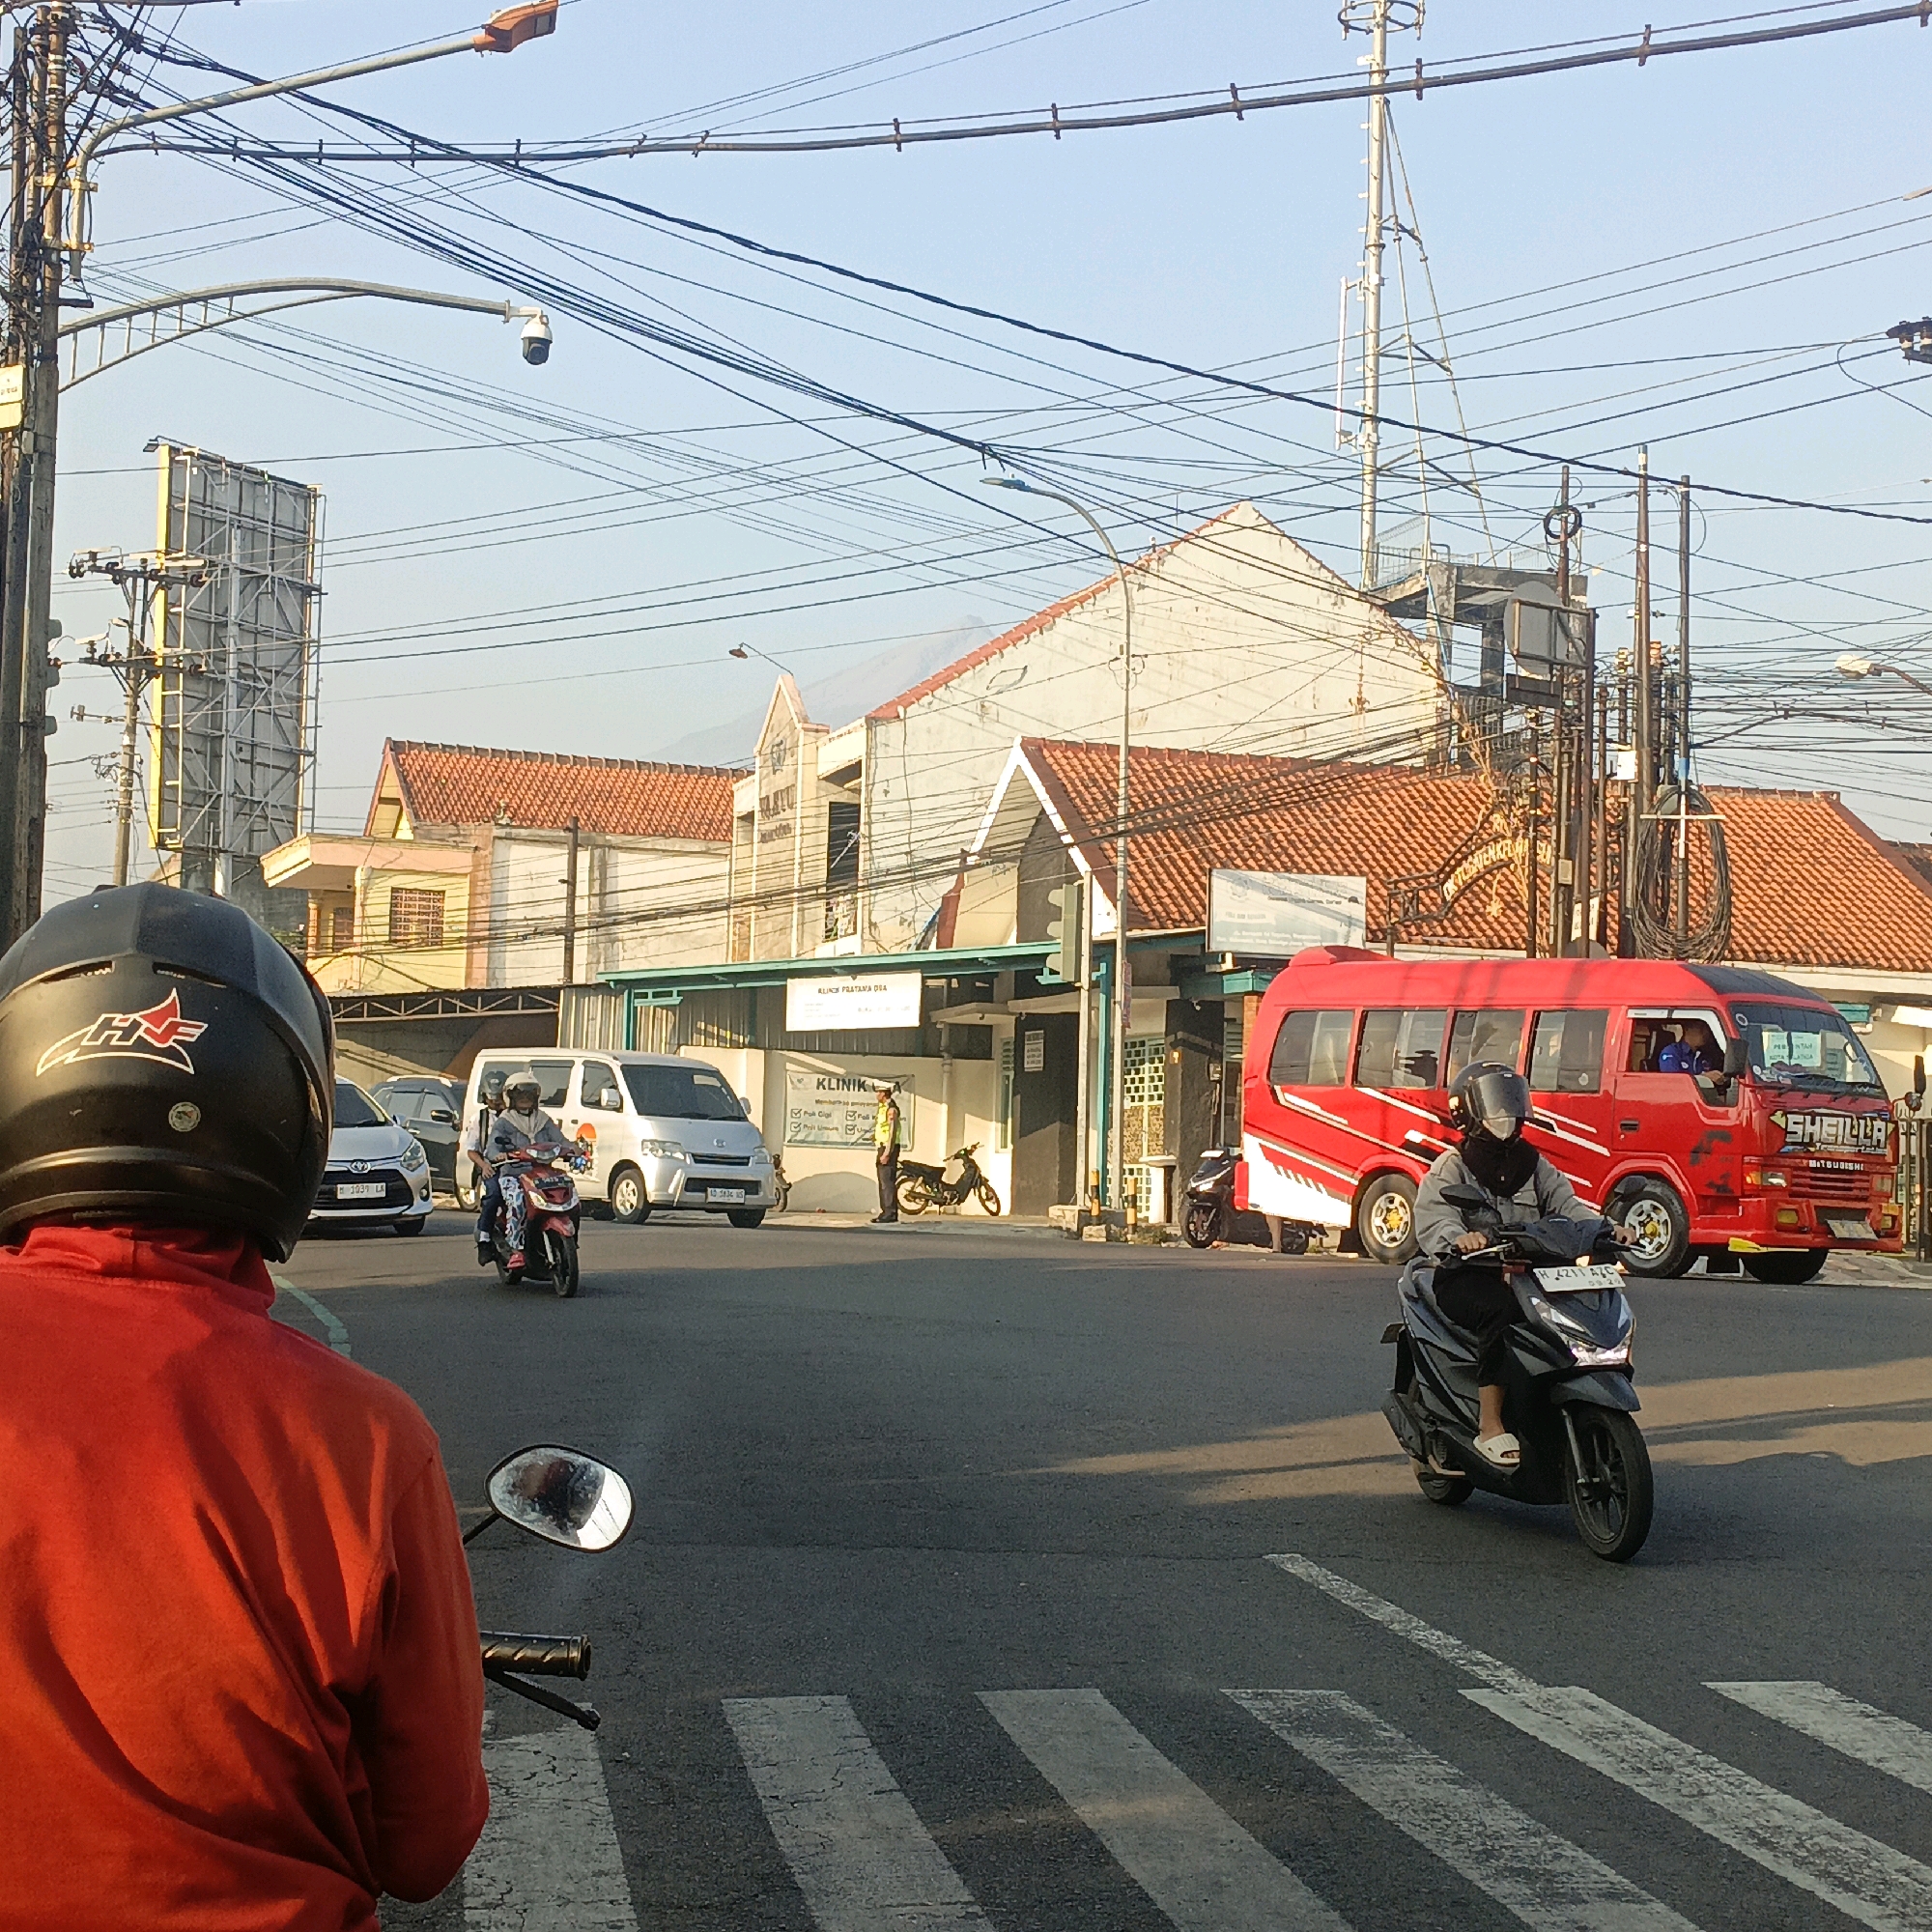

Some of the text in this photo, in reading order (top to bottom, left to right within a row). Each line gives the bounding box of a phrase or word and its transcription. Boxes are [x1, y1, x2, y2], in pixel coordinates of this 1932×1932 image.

[816, 1077, 867, 1093] KLINIK
[1785, 1114, 1886, 1149] SHEILLA
[1808, 1159, 1864, 1171] MITSUBISHI
[1538, 1269, 1549, 1280] H
